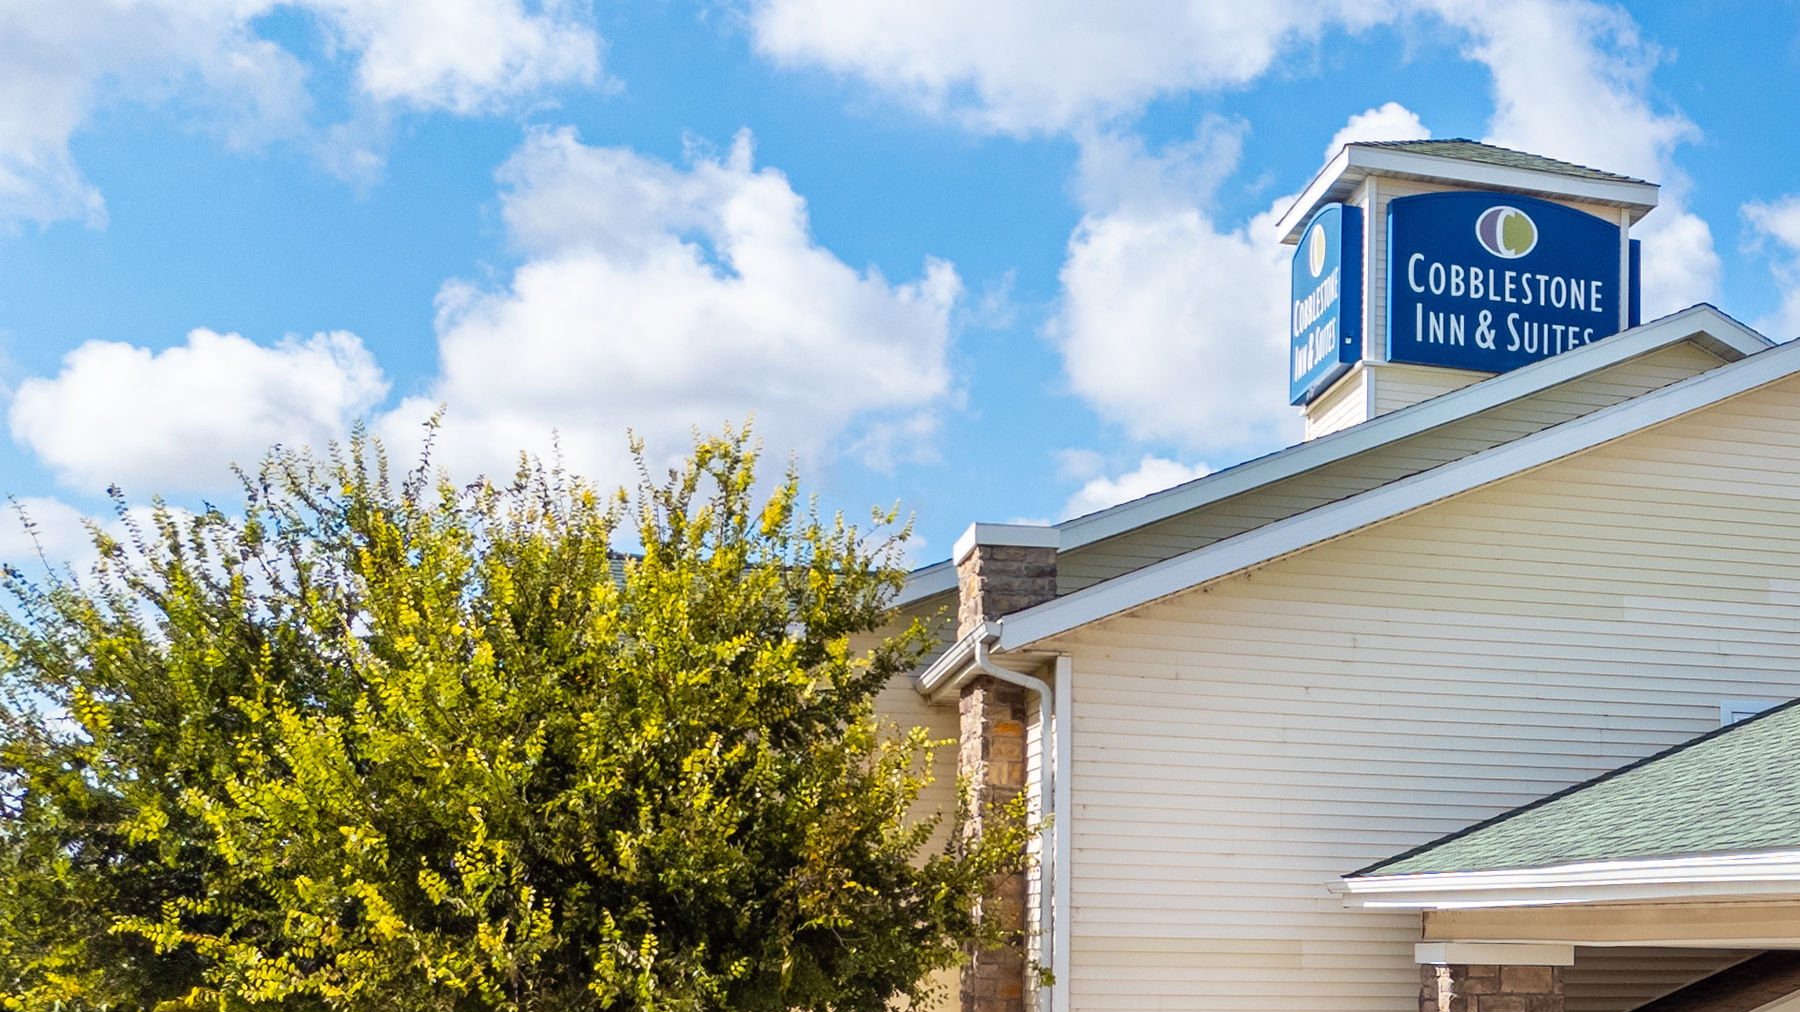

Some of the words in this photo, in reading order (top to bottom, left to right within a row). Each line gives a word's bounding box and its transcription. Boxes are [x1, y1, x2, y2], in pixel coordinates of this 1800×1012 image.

[1407, 252, 1603, 313] COBBLESTONE
[1415, 302, 1465, 347] INN
[1475, 309, 1497, 350] &
